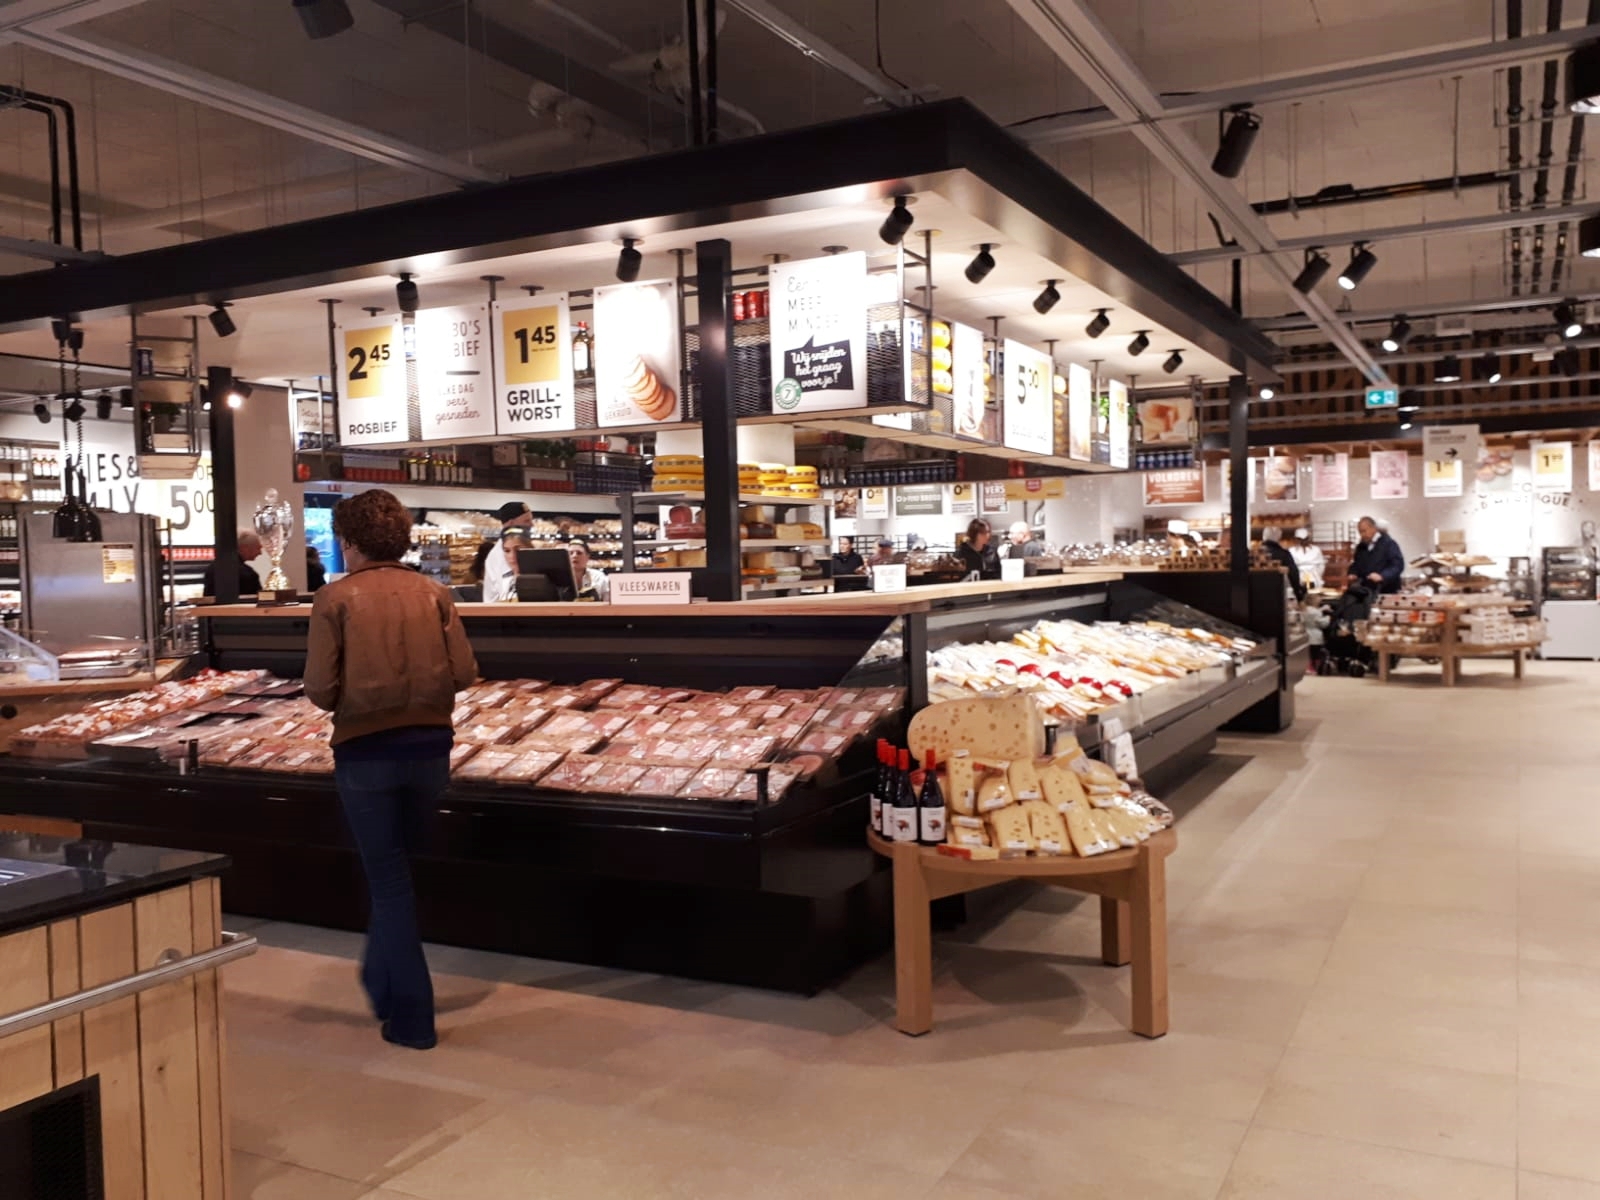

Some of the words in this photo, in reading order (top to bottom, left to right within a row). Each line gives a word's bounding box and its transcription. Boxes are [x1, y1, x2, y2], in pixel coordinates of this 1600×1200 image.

[507, 389, 561, 406] GRILL-
[507, 406, 562, 422] WORST
[349, 421, 398, 436] ROSBIEF
[618, 581, 680, 592] VLEESWAREN
